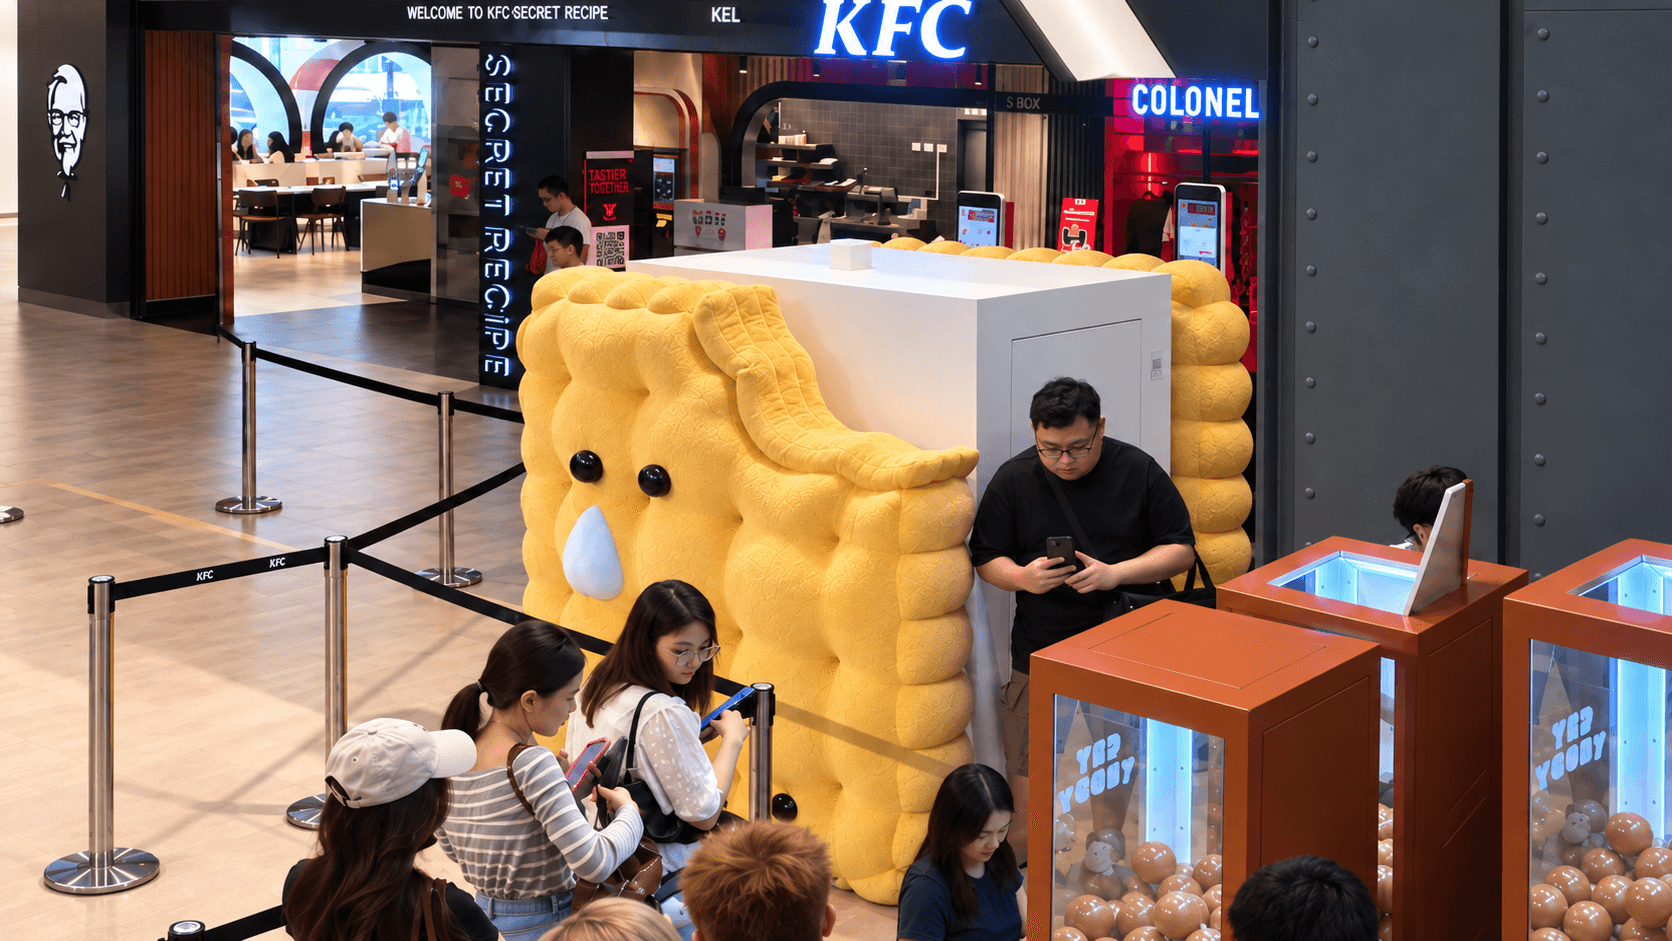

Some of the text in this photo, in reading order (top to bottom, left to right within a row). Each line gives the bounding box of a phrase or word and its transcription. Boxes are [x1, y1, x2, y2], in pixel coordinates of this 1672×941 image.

[407, 6, 463, 19] WELCOME
[468, 6, 483, 19] TO
[565, 6, 608, 19] RECIPE
[711, 6, 741, 23] KEL
[814, 0, 972, 58] KFC
[1006, 96, 1041, 110] S BOX
[1132, 84, 1259, 118] COLONEL
[484, 53, 511, 216] SECRET
[588, 168, 627, 181] TASTIER
[589, 181, 630, 194] TOGETHER
[196, 557, 286, 581] KFC KFC
